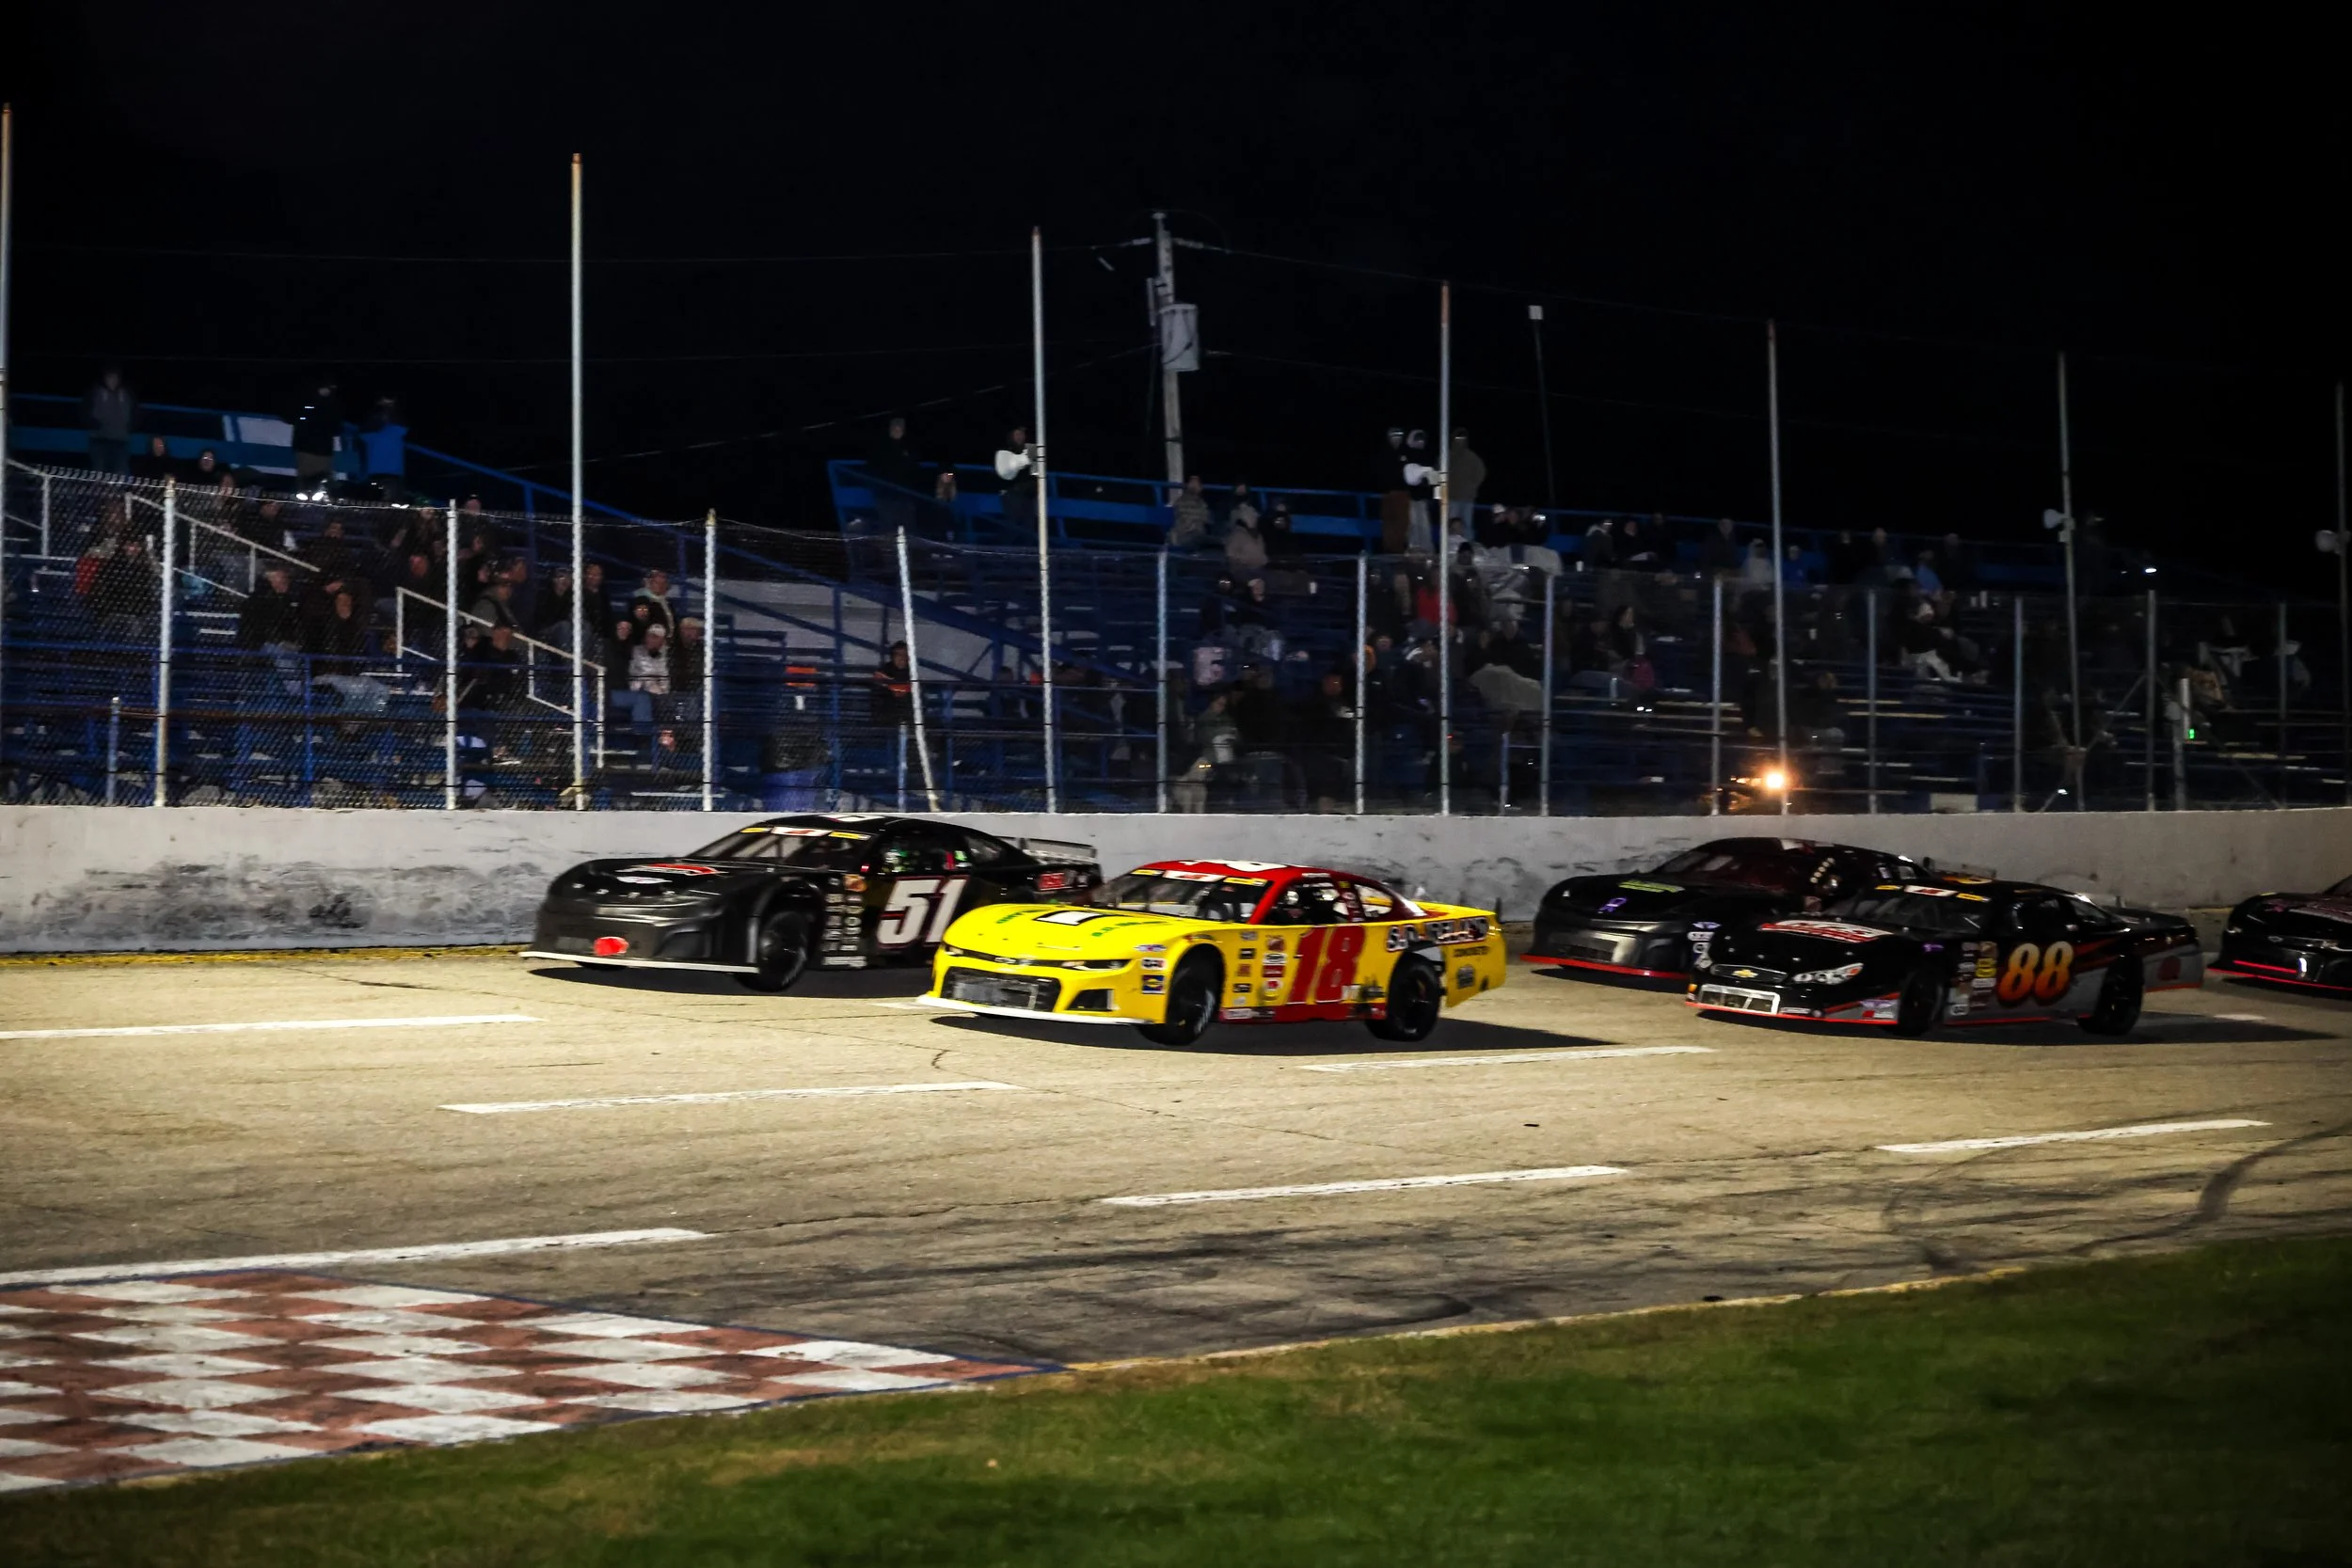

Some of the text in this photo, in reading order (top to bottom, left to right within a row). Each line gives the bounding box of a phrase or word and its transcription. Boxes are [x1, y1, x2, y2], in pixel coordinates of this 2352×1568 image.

[877, 876, 969, 949] 51
[1286, 925, 1366, 1005] 18
[1998, 941, 2074, 1001] 88
